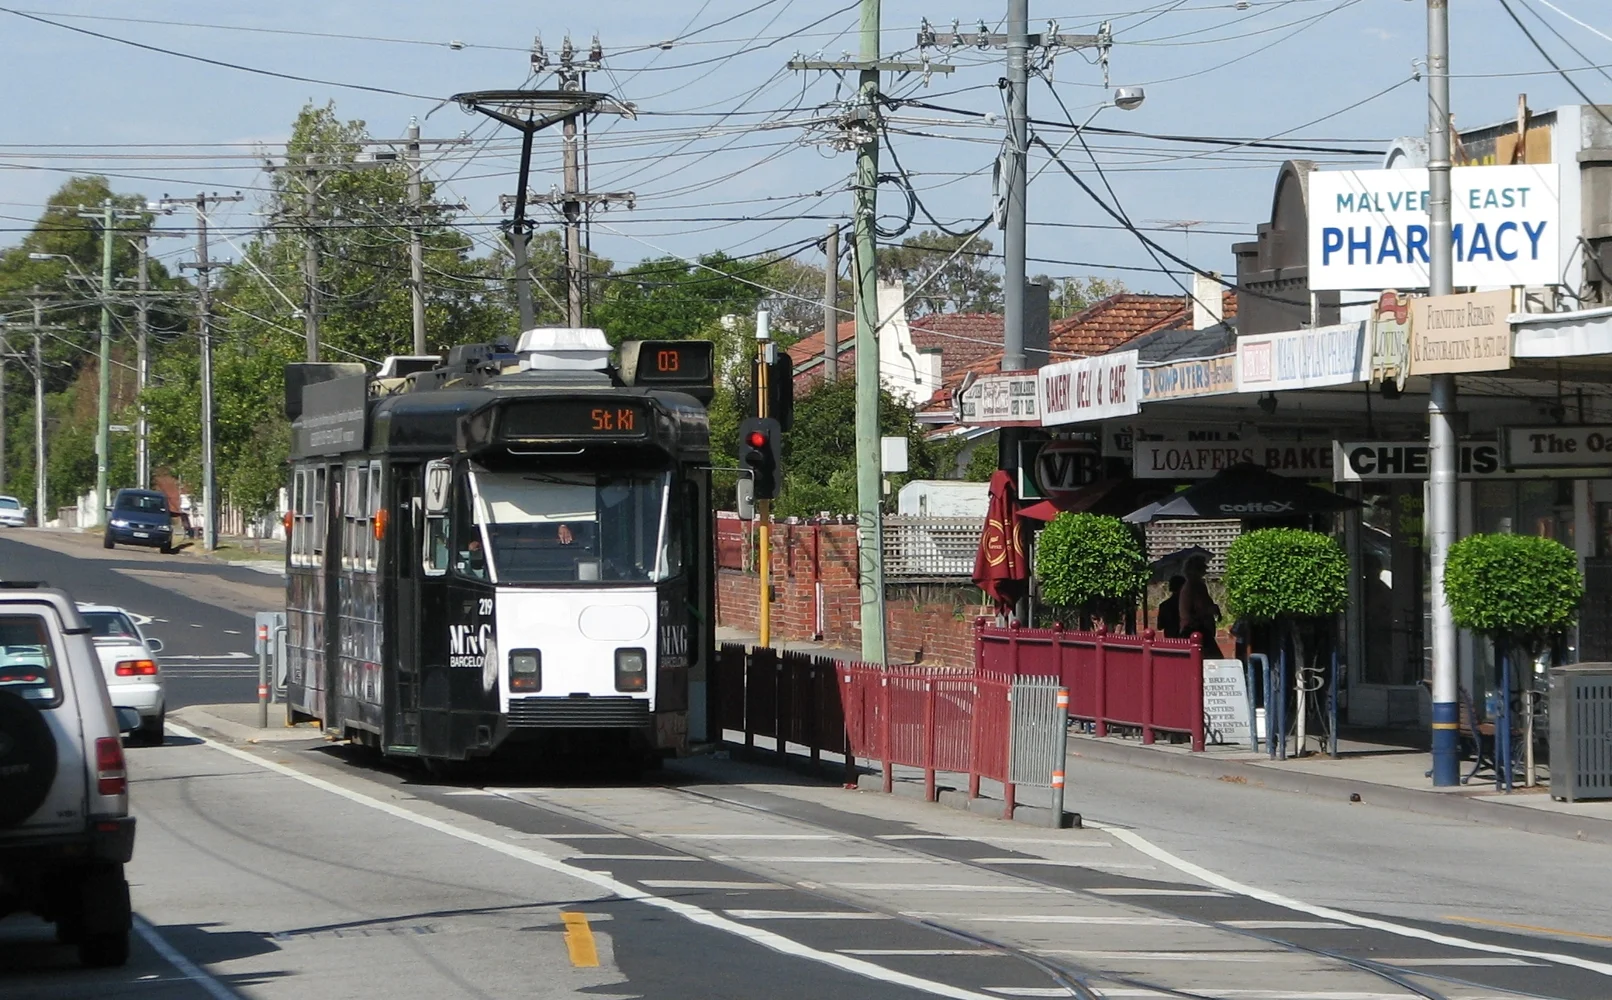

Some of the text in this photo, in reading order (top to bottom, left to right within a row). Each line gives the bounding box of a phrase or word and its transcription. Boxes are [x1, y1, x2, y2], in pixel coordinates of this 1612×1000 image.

[1336, 187, 1531, 213] MALVE EAST
[658, 351, 679, 371] 03
[1046, 373, 1071, 413] BAKERY
[1077, 370, 1092, 408] DELI
[1097, 368, 1102, 406] &
[1109, 365, 1126, 404] CAFE
[1153, 364, 1210, 393] COMPUTERS
[591, 409, 612, 430] St
[1529, 434, 1577, 453] The
[1152, 449, 1253, 471] LOAFERS
[1349, 446, 1514, 474] CHEIS
[479, 598, 493, 615] 219
[661, 625, 688, 655] MNG
[450, 656, 485, 667] BARCELO
